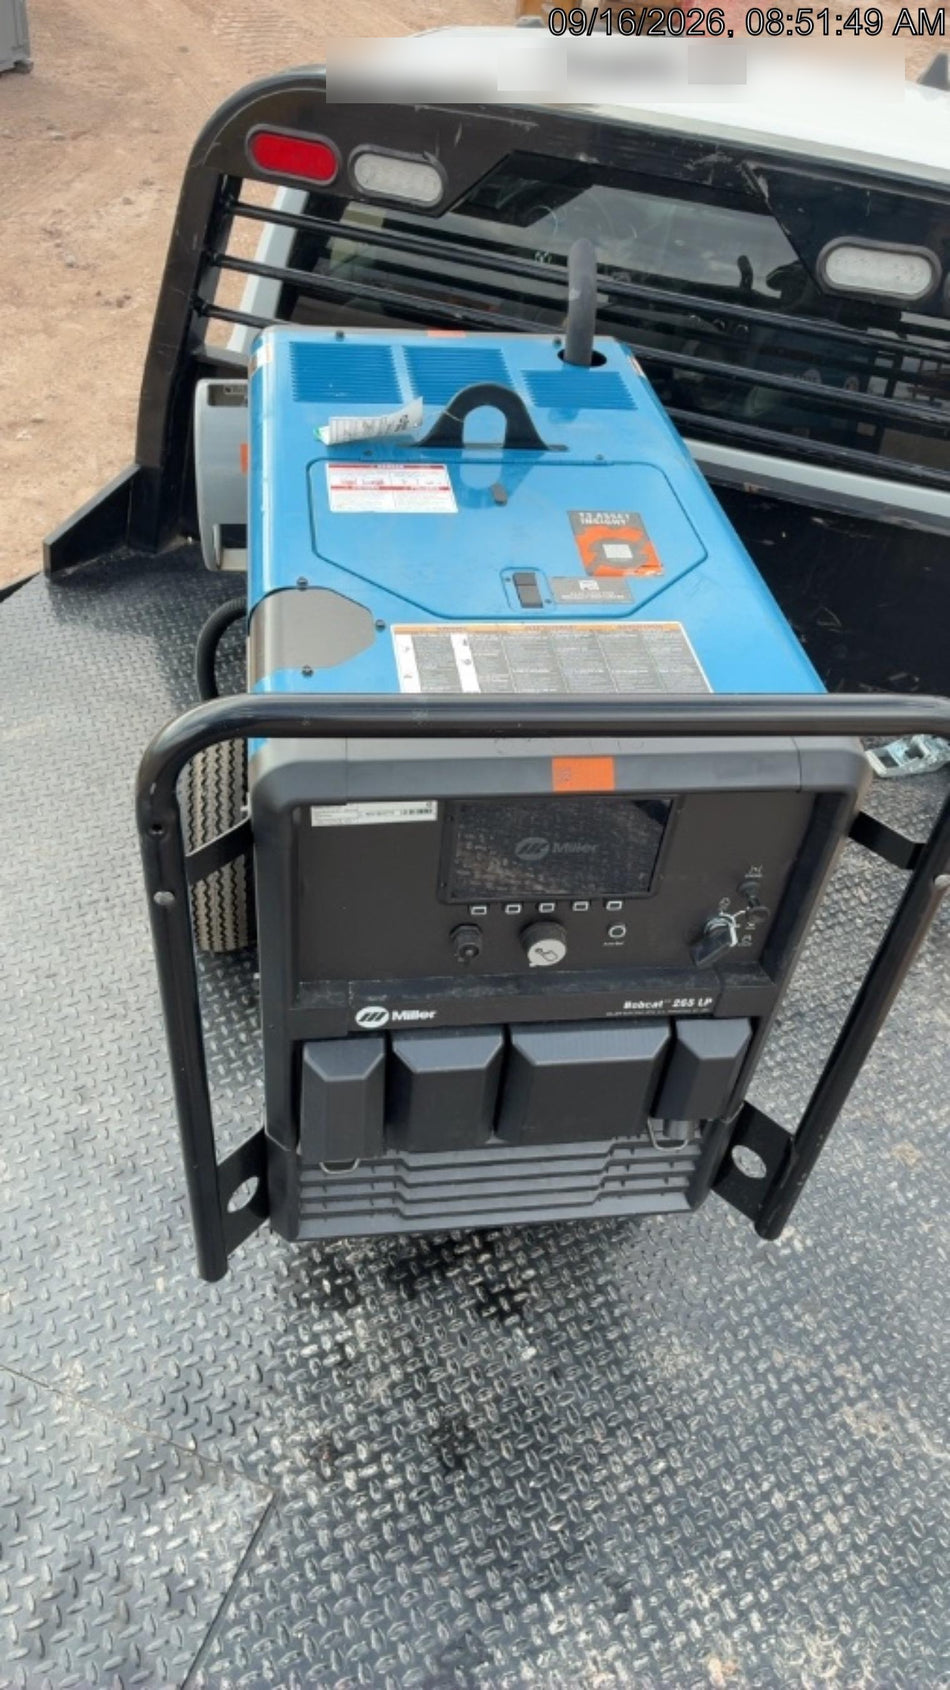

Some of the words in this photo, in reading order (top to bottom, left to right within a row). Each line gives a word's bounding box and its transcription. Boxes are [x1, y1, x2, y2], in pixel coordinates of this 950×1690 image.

[552, 842, 599, 854] Miller
[671, 998, 696, 1008] 265
[697, 997, 713, 1008] LP
[391, 1010, 437, 1021] Miller
